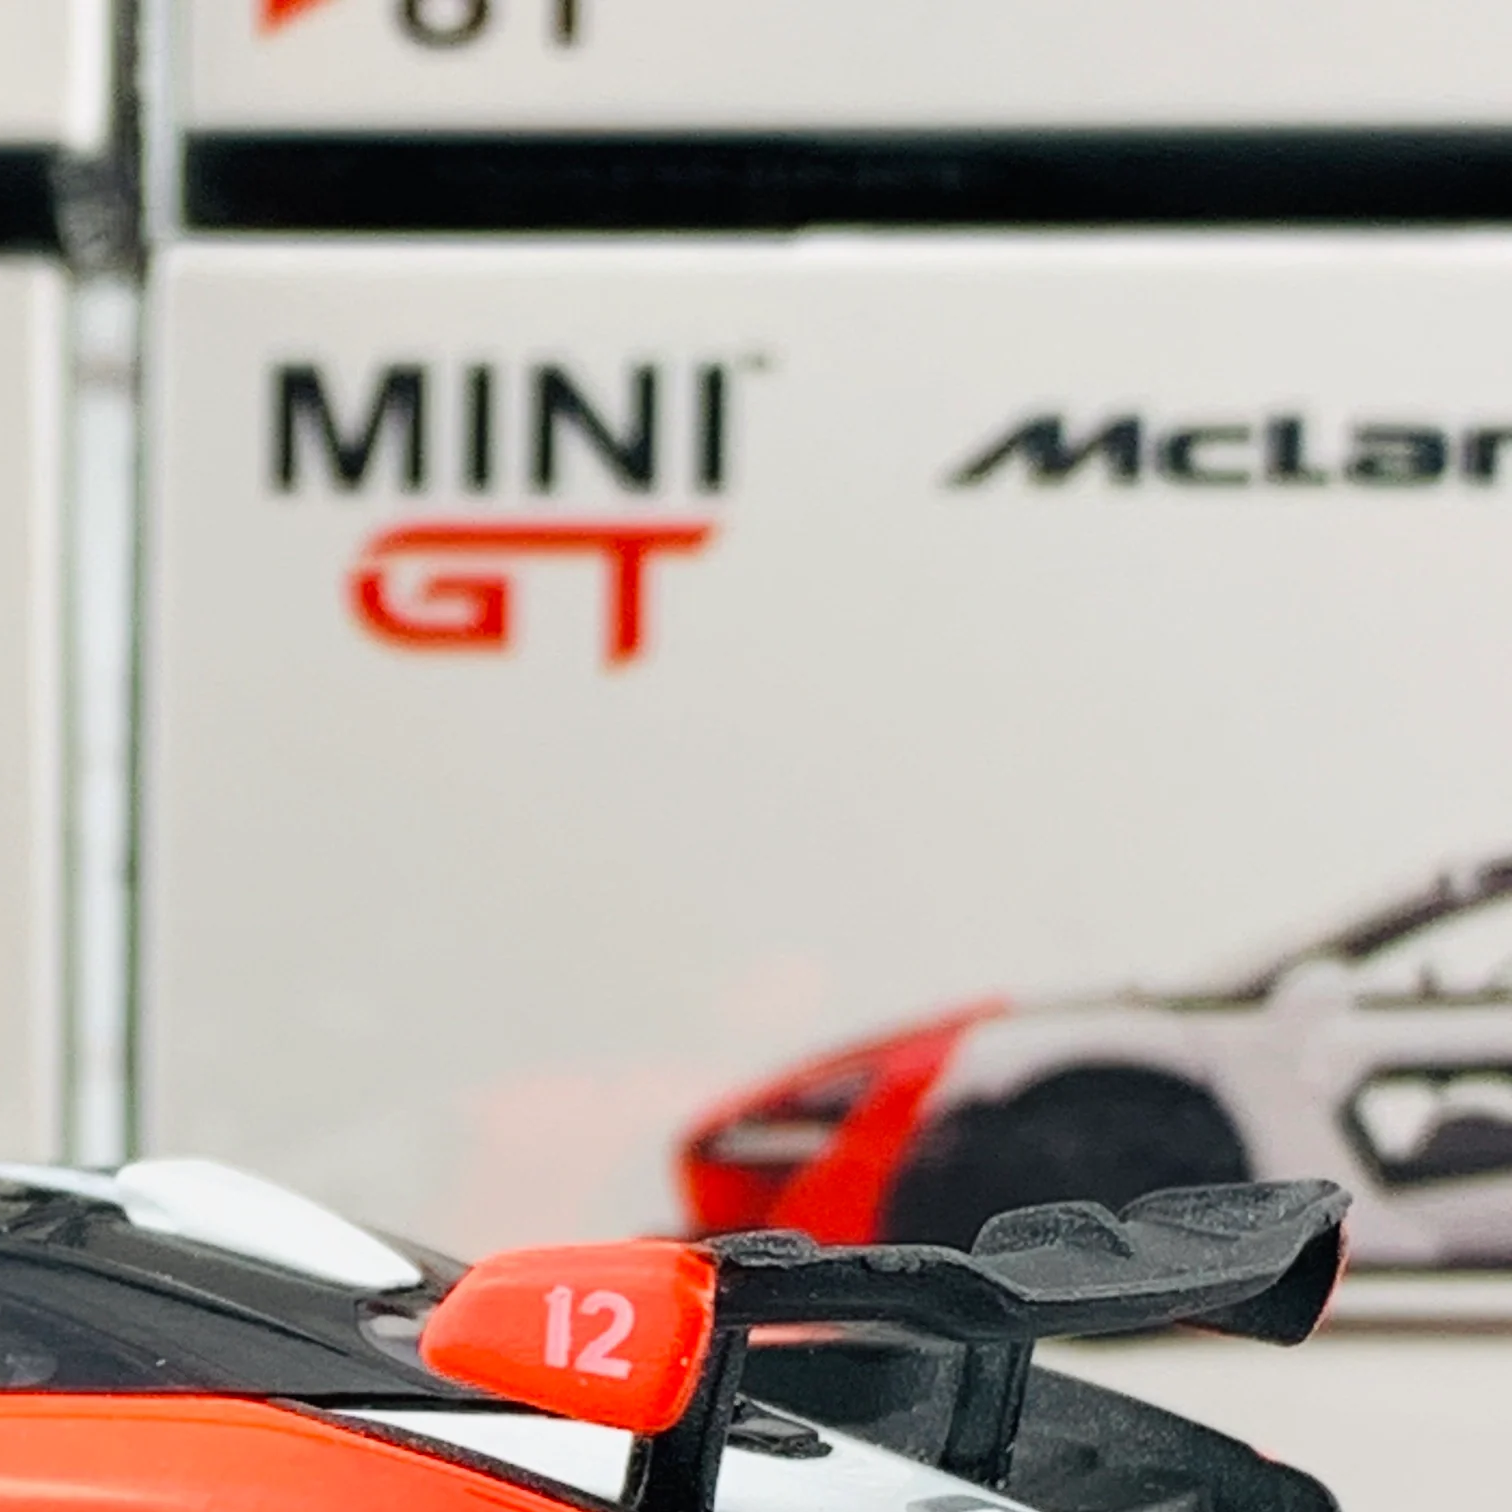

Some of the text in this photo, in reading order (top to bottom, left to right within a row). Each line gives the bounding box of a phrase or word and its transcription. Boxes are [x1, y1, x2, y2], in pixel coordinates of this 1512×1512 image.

[271, 362, 730, 494] MINI
[346, 522, 718, 670] GT
[541, 1283, 635, 1381] 12
